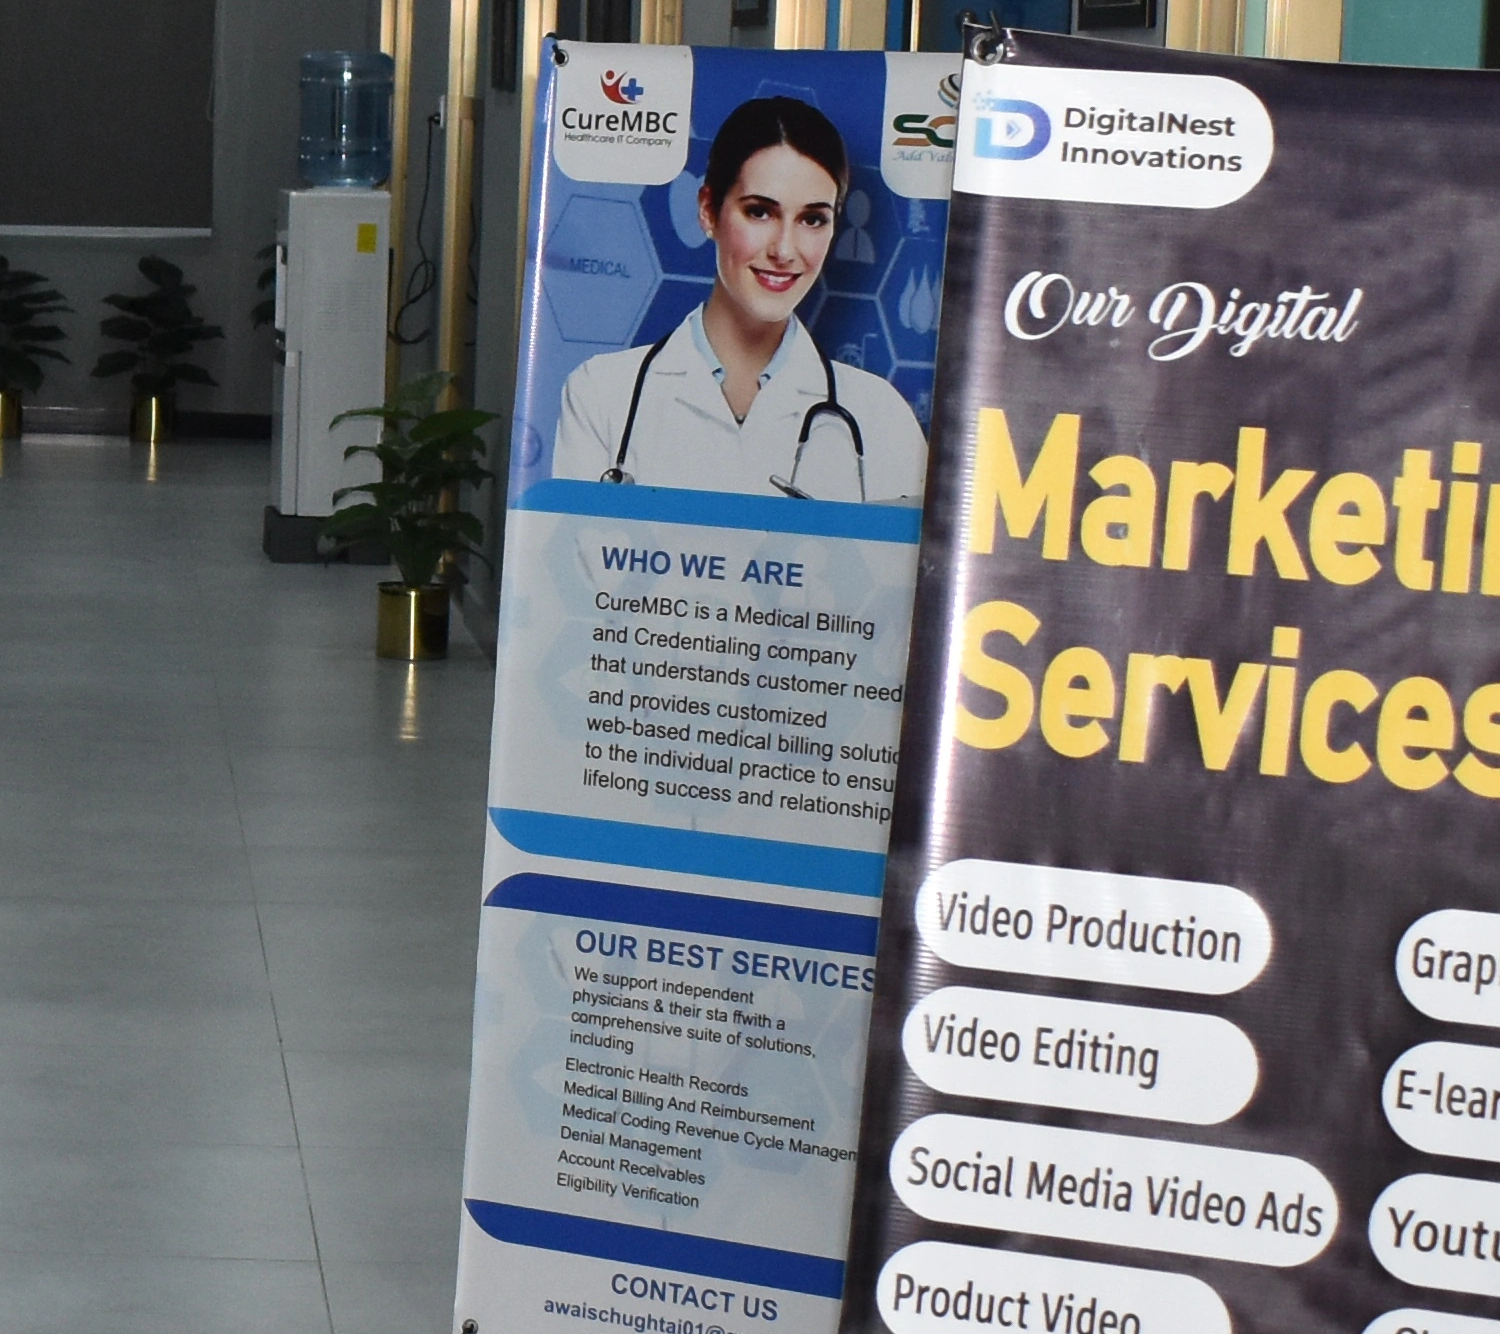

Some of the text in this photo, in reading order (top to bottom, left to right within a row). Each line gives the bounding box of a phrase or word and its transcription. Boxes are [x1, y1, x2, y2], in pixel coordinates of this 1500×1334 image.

[562, 108, 677, 133] CureMBC
[1065, 107, 1235, 136] DigitalNest
[1062, 142, 1241, 171] Innovations
[1004, 271, 1364, 361] Our Digital
[602, 546, 803, 587] WHO WE ARE
[593, 626, 857, 670] and Credentialing company
[940, 892, 1240, 962] Video Production
[576, 930, 875, 991] OUR BEST SERVICES
[926, 1014, 1159, 1089] Video Editing
[566, 1057, 748, 1097] Electronic Health Records
[908, 1147, 1323, 1237] Social Media Video Ads
[612, 1274, 777, 1321] CONTACT US
[894, 1274, 1029, 1329] Product
